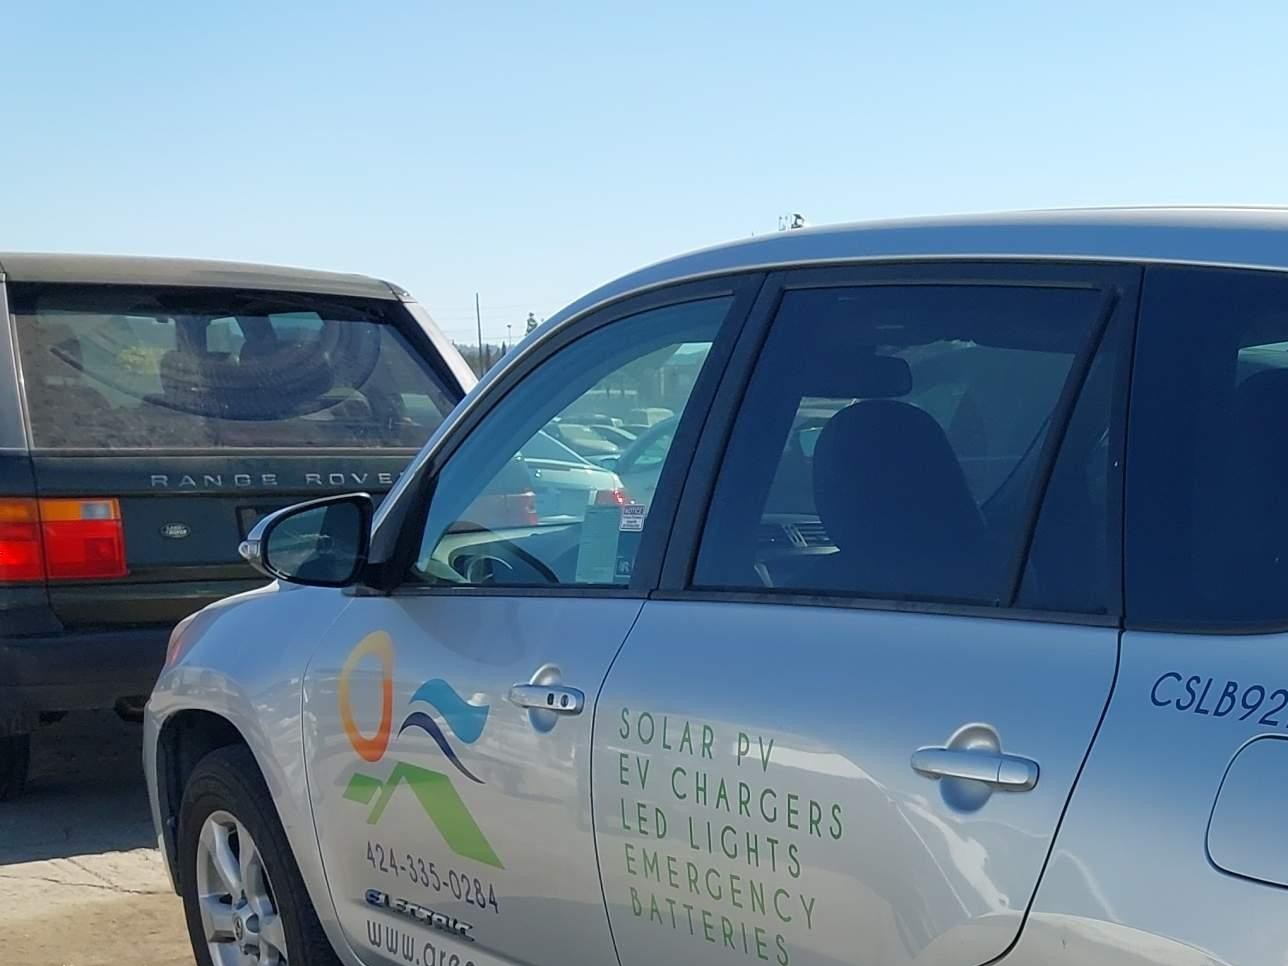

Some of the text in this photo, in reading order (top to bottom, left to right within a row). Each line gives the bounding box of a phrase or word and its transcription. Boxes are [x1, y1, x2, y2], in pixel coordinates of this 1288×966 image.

[150, 472, 396, 488] RANGE ROVE
[618, 706, 775, 773] SOLAR PV
[618, 752, 843, 840] EV CHARGERS
[366, 840, 500, 914] 424-335-0284
[620, 797, 801, 879] LED LIGHTS
[624, 842, 816, 930] EMERGENCY
[629, 886, 789, 966] BATTERIES
